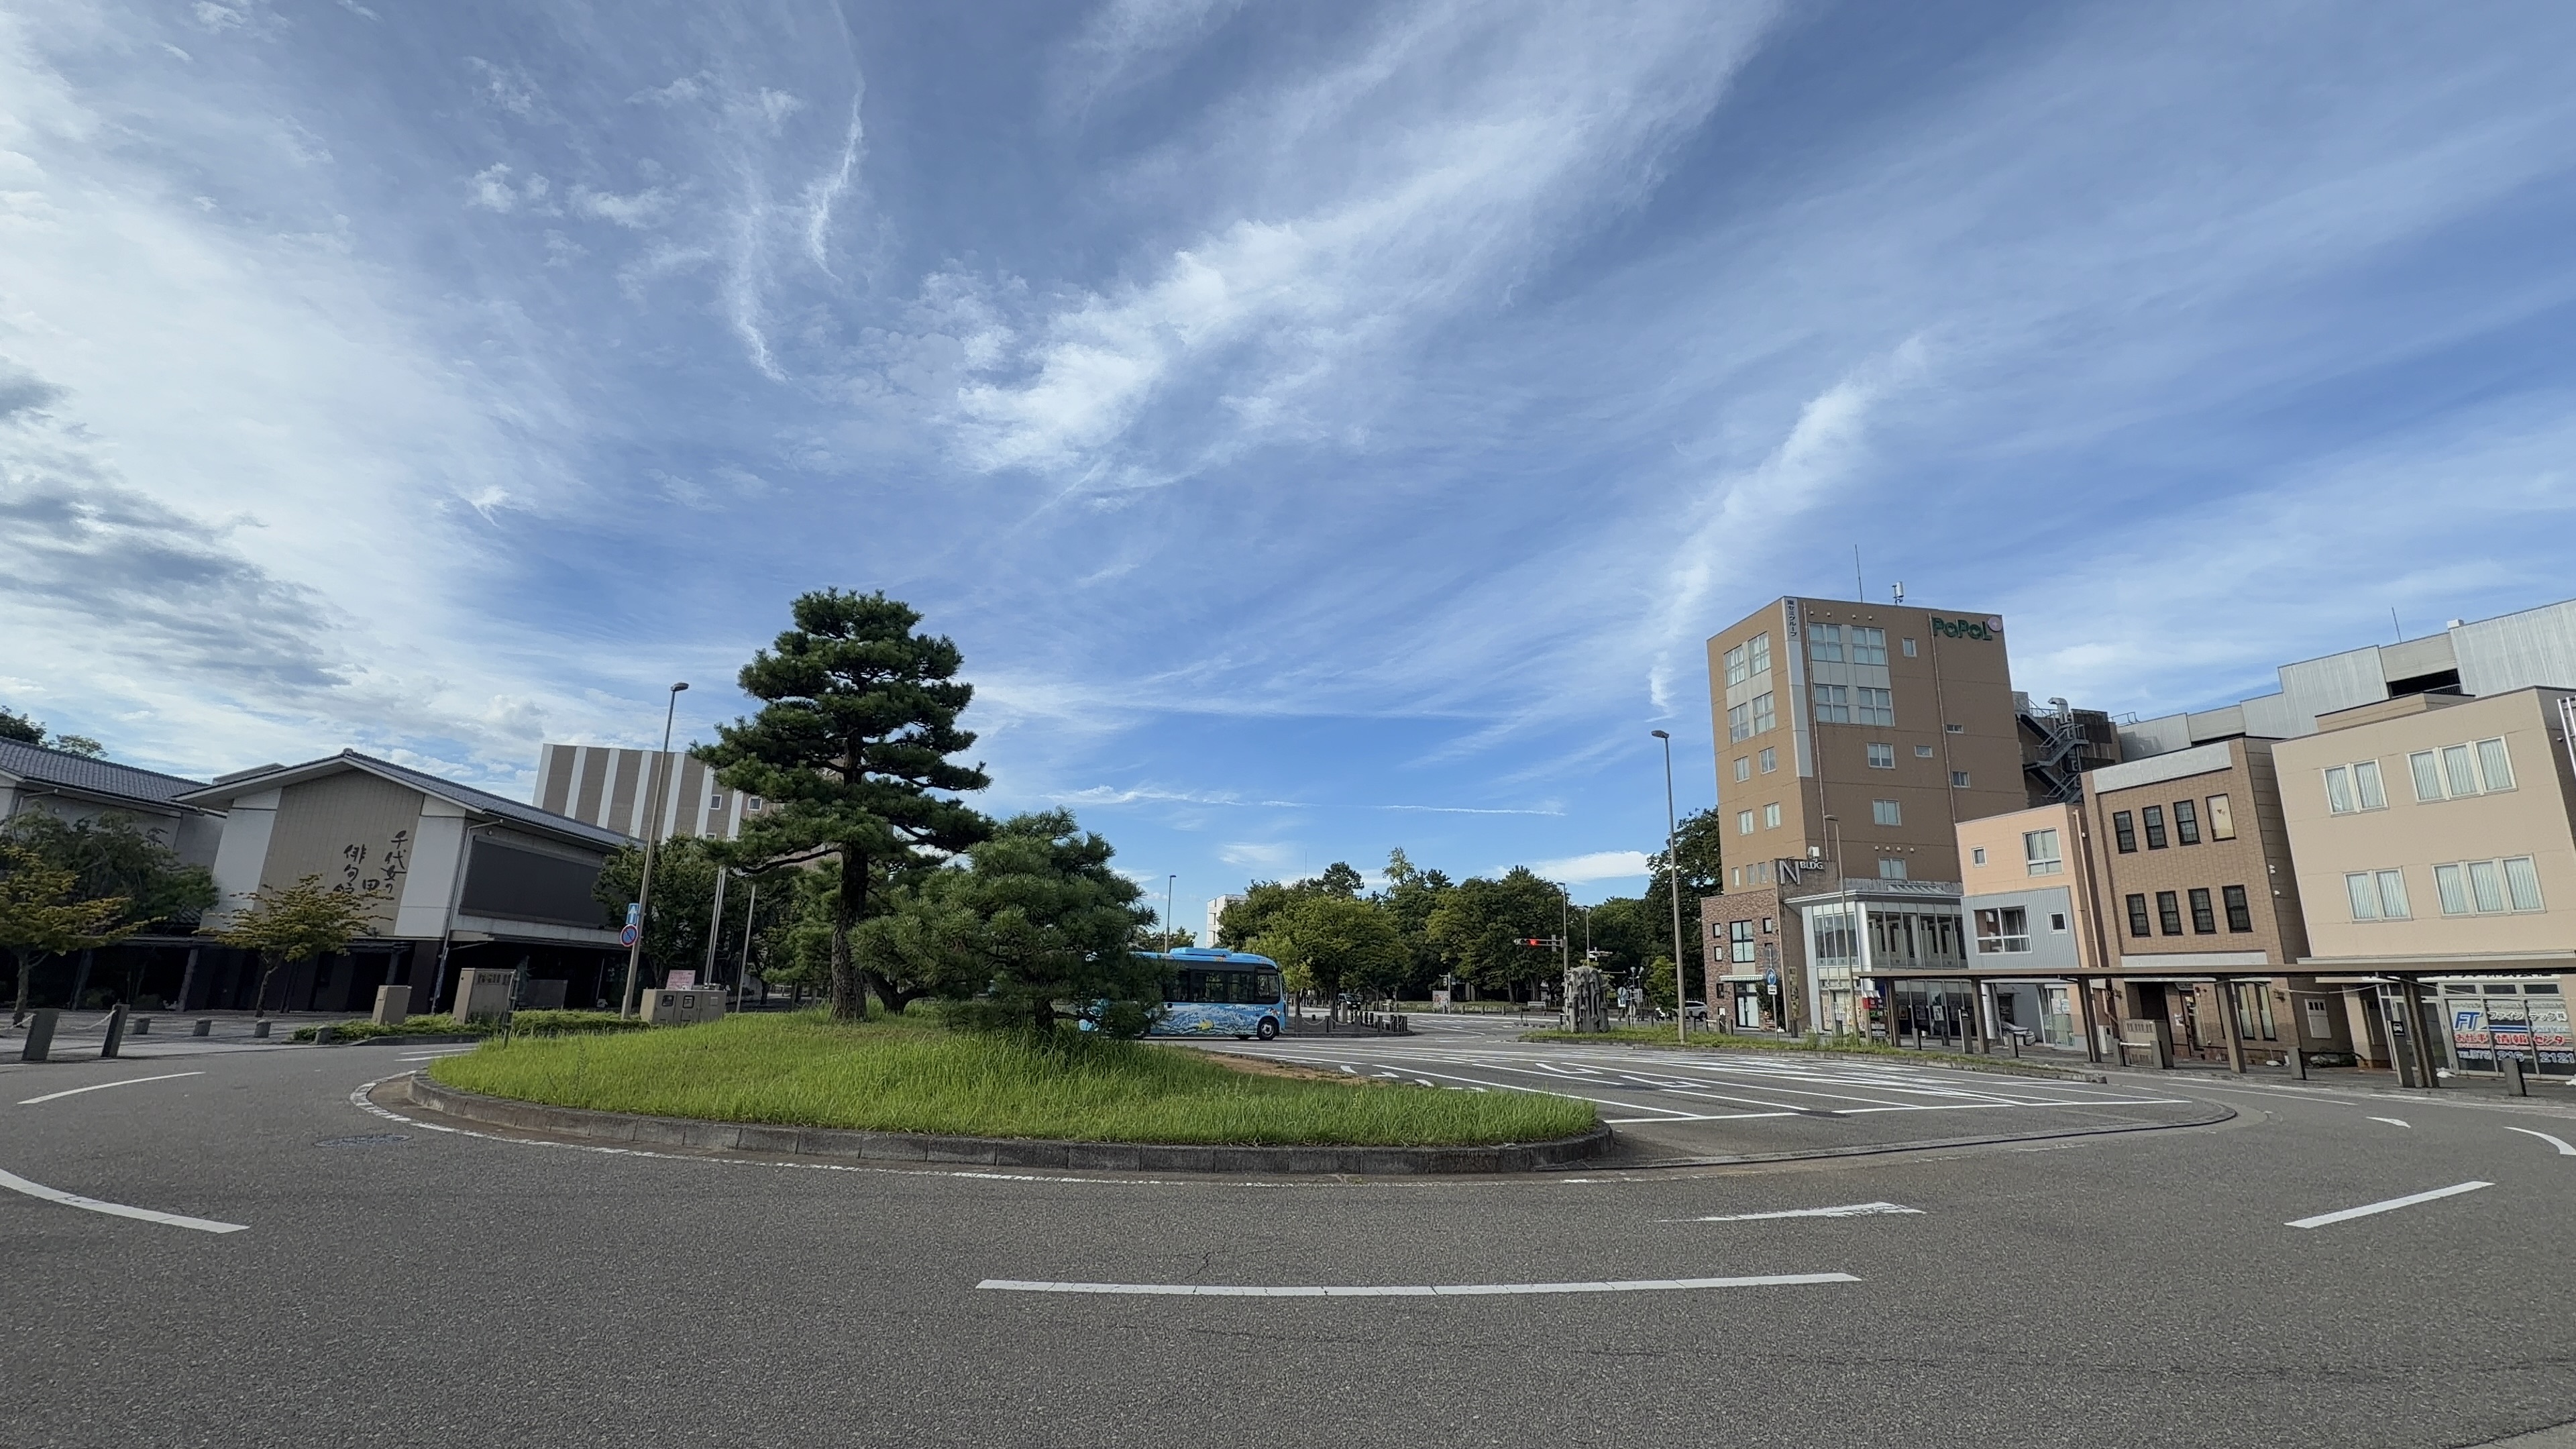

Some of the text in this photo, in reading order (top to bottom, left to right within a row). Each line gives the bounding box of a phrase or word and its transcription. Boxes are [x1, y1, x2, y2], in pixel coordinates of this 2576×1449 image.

[1779, 860, 1823, 885] N BLDG
[2454, 1011, 2482, 1030] FT
